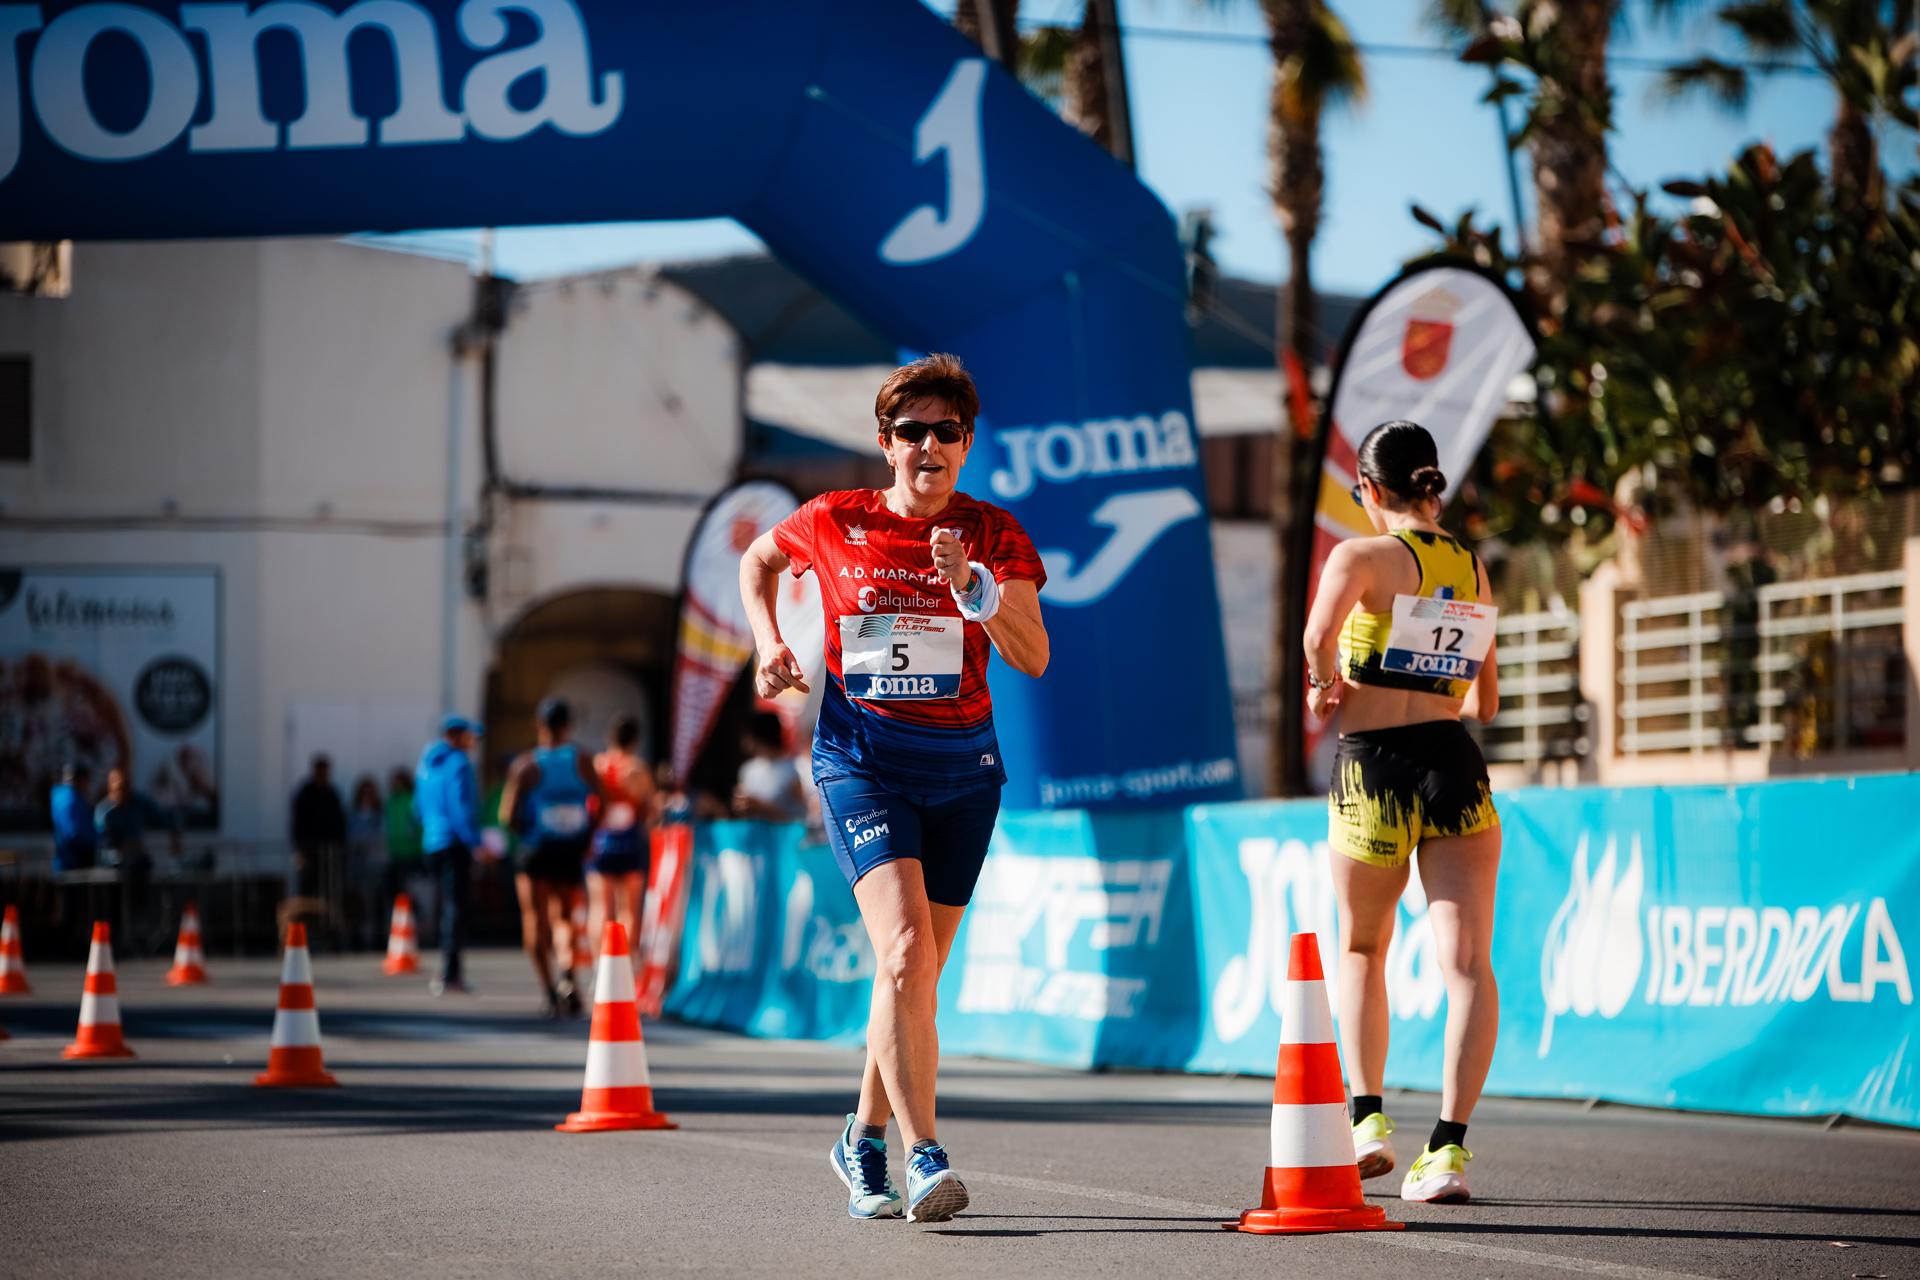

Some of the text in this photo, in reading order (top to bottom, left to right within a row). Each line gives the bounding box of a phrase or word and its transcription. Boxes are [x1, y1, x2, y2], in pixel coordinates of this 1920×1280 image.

[839, 566, 868, 578] A.D.
[878, 589, 942, 613] alquiber
[1432, 626, 1464, 653] 12
[891, 643, 910, 672] 5
[855, 808, 889, 825] alquiber
[854, 823, 890, 849] ADM
[1645, 896, 1914, 1007] IBERDROLA
